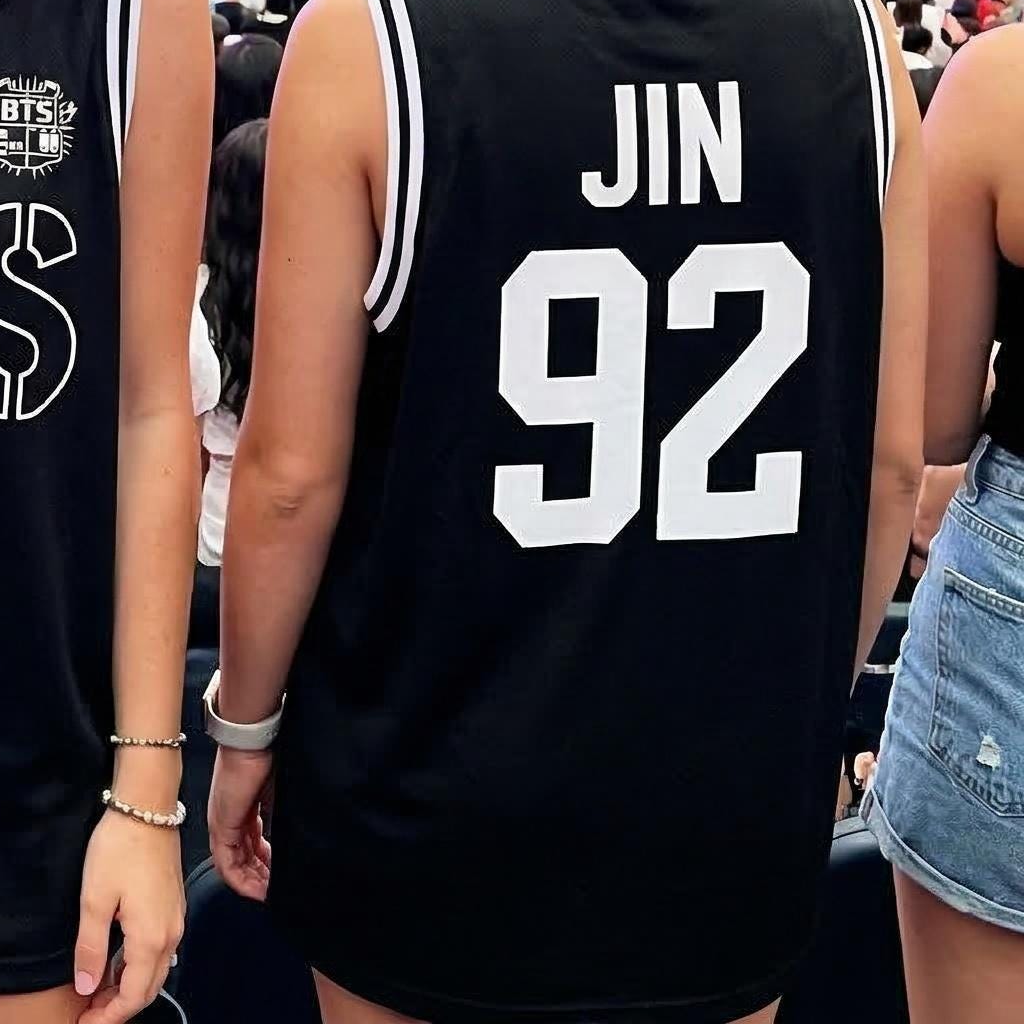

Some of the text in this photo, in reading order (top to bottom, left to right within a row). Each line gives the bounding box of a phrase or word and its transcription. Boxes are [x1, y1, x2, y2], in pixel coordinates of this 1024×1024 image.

[0, 98, 54, 124] BTS
[581, 80, 743, 208] JIN
[492, 240, 812, 549] 92
